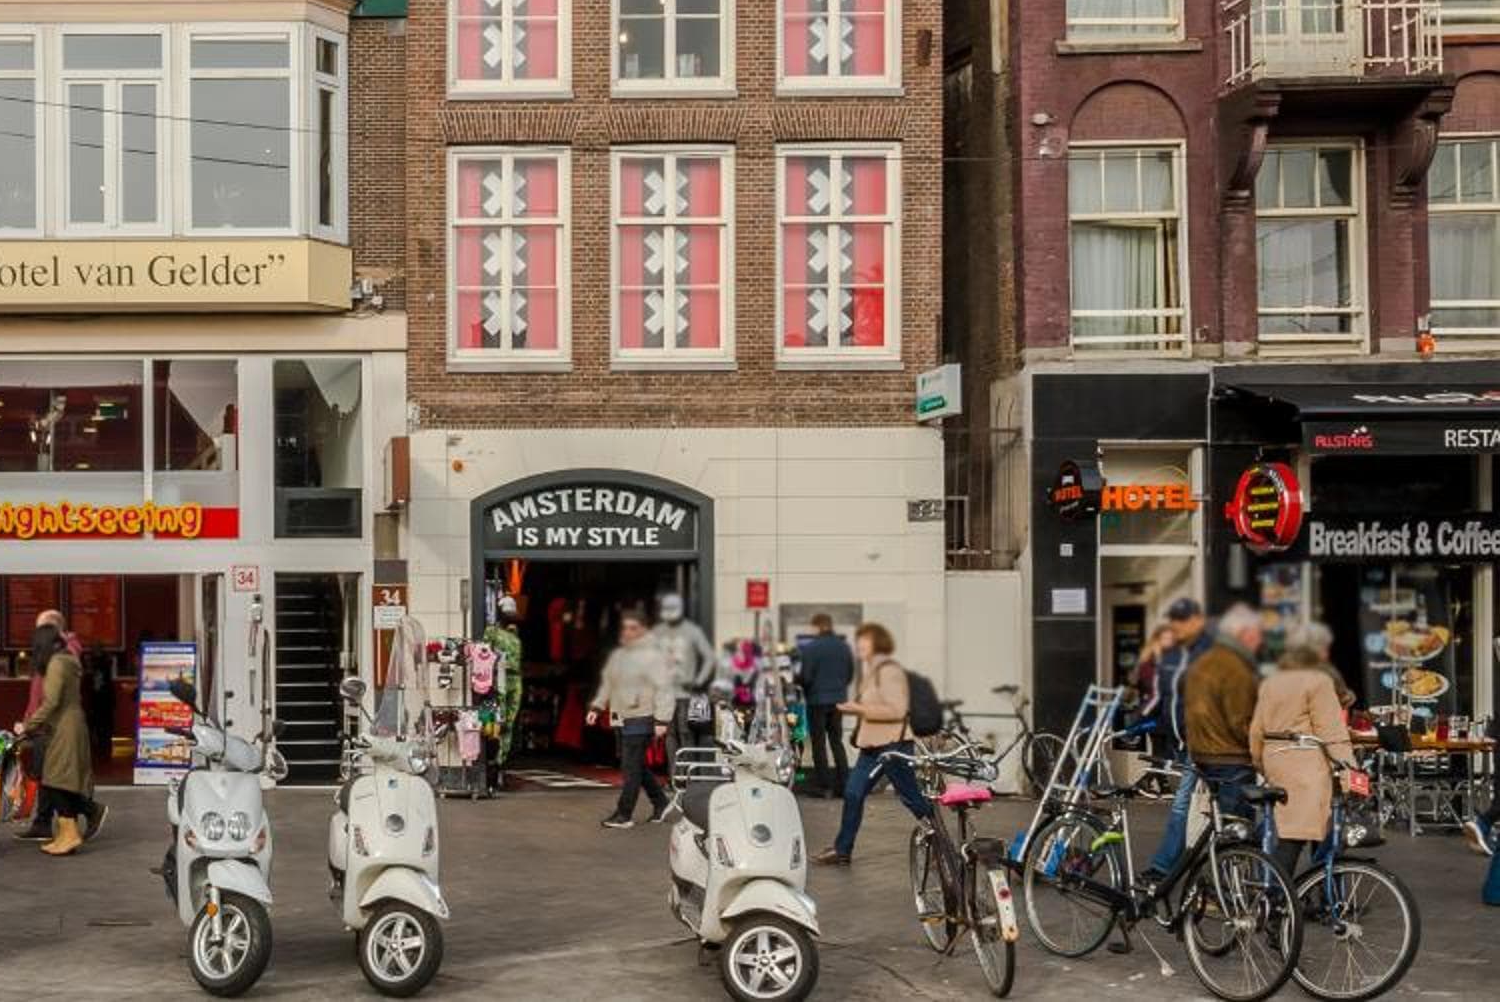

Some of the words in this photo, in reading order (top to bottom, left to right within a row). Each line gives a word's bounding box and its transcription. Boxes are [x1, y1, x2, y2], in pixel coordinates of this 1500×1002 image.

[75, 263, 134, 287] van
[491, 488, 687, 532] AMSTERDAM
[1101, 486, 1198, 510] HOTEL
[516, 527, 539, 546] IS
[545, 527, 582, 546] MY
[588, 527, 660, 546] STYLE
[1309, 521, 1411, 556] Breakfast
[1415, 521, 1433, 555] &
[1437, 521, 1500, 556] Coffee
[238, 571, 254, 585] 34
[379, 589, 401, 606] 34
